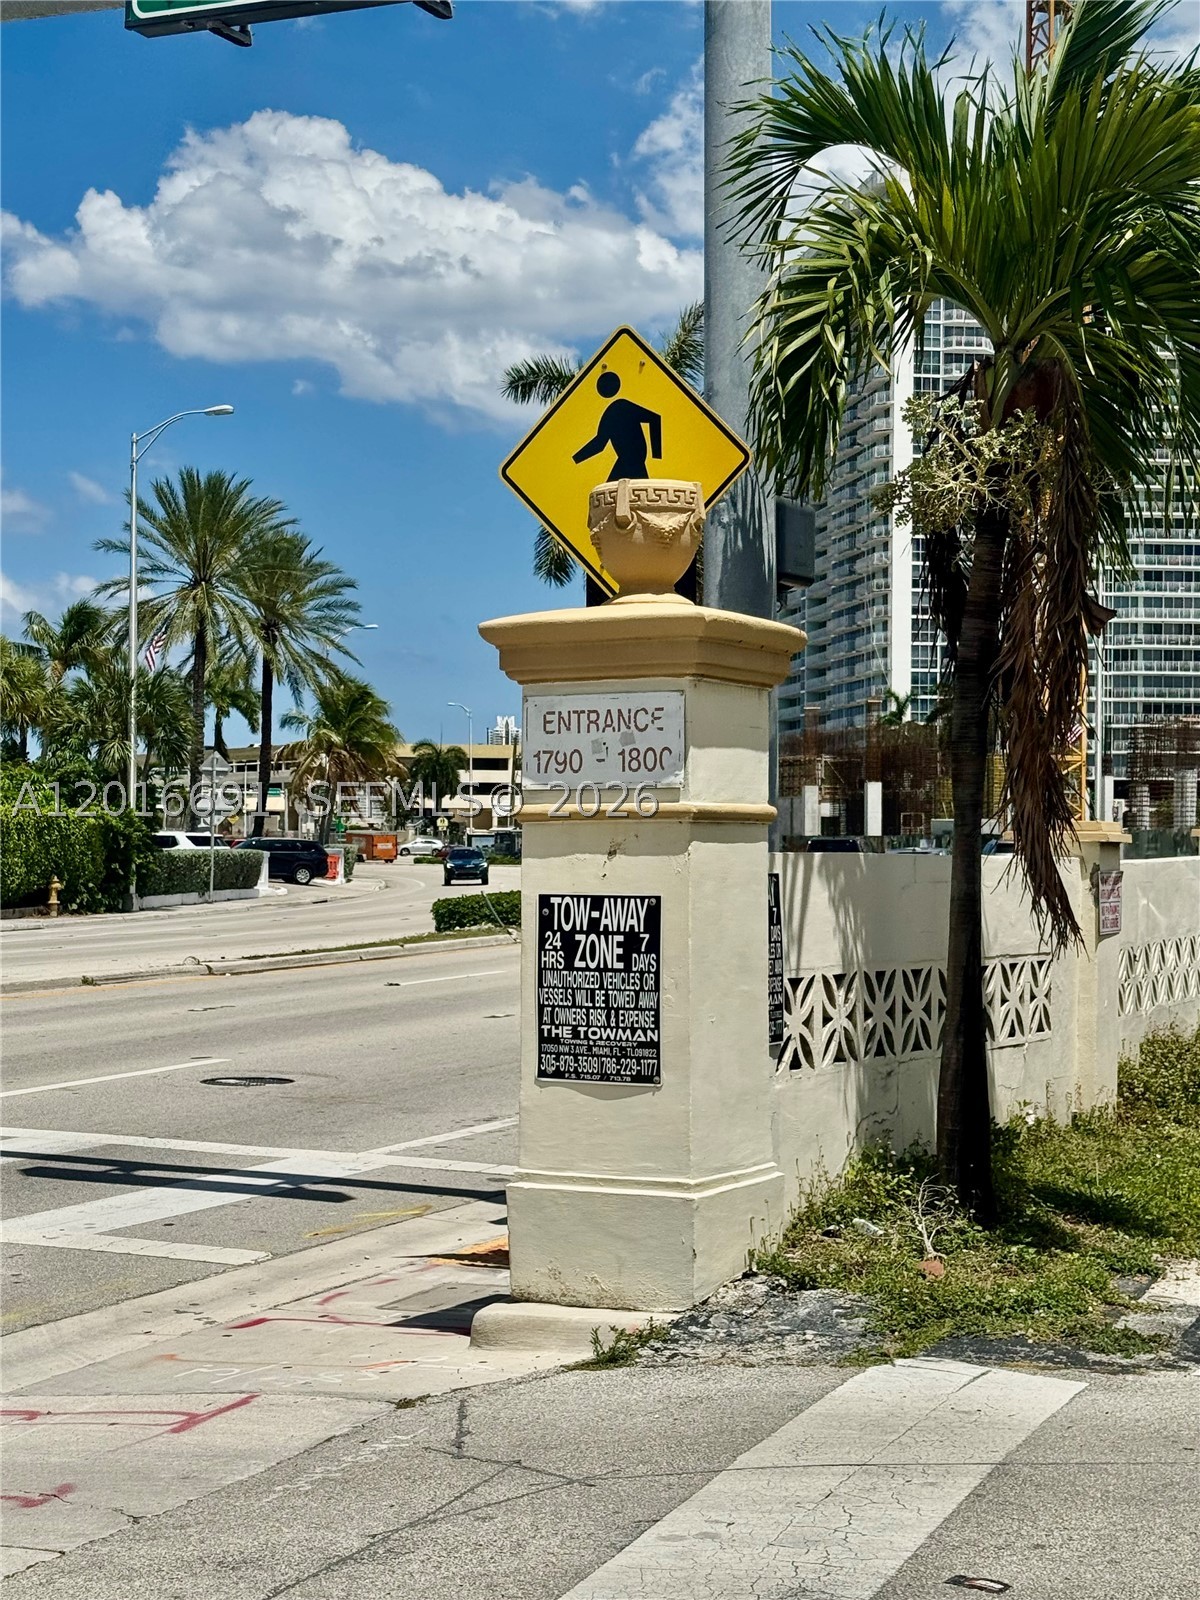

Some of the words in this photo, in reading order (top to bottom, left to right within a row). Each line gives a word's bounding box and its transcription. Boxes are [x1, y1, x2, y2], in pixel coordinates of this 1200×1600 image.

[543, 707, 664, 735] ENTRANCE
[533, 748, 583, 774] 1790
[550, 896, 649, 932] TOW-AWAY
[772, 908, 777, 924] 7
[545, 931, 562, 950] 24
[574, 934, 624, 969] ZONE
[640, 934, 649, 952] 7
[541, 951, 565, 969] HRS
[632, 954, 656, 972] DAYS
[543, 971, 600, 988] UNAUTHORIZED
[603, 972, 640, 990] VEHICLES
[643, 974, 655, 990] OR
[539, 988, 572, 1006] VESSELS
[575, 990, 592, 1006] WILL
[595, 991, 606, 1007] BE
[608, 991, 635, 1008] TOWED
[638, 992, 658, 1009] AWAY
[543, 1007, 551, 1024] AT
[554, 1008, 586, 1026] OWNERS
[589, 1009, 607, 1026] RISK
[610, 1010, 616, 1027] &
[619, 1010, 655, 1028] EXPENSE
[541, 1025, 572, 1038] THE
[577, 1027, 658, 1042] TOWMAN
[541, 1044, 558, 1053] 17050
[559, 1045, 569, 1053] NW
[592, 1047, 612, 1056] MIAMI,
[613, 1048, 621, 1056] FL
